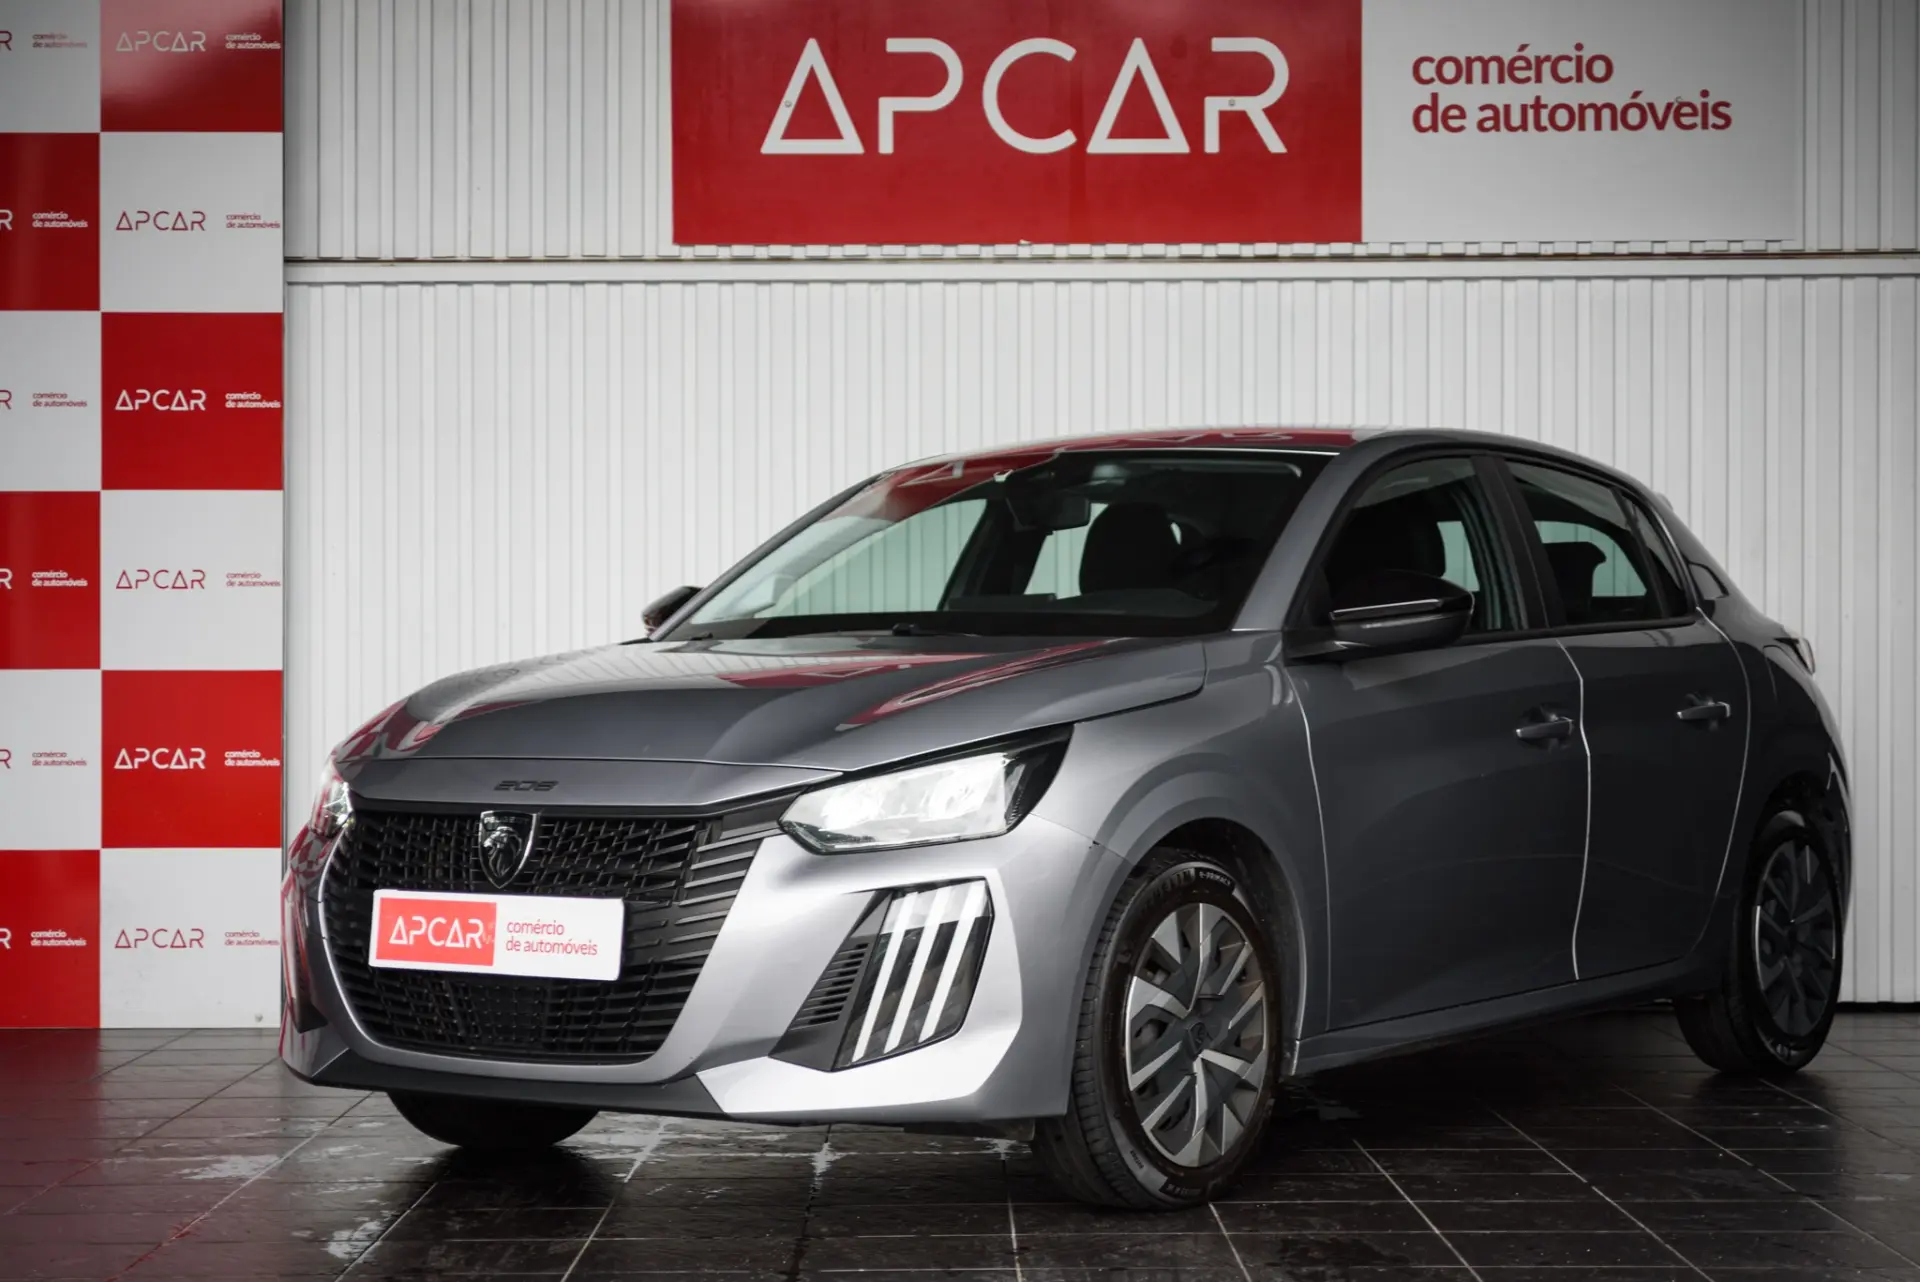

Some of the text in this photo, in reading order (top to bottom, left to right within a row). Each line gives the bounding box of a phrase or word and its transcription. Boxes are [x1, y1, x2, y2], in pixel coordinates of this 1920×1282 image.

[116, 31, 206, 51] APCAR
[1411, 42, 1614, 85] comércio
[760, 37, 1290, 155] APCAR
[1411, 89, 1733, 133] de automóveis
[116, 211, 206, 231] APCAR
[115, 389, 206, 411] APCAR
[116, 569, 206, 589] APCAR
[114, 748, 206, 769] APCAR
[494, 780, 559, 791] 208
[389, 916, 485, 949] APCAR
[506, 919, 565, 936] comércio
[115, 928, 204, 948] APCAR
[506, 936, 598, 956] de automóveis
